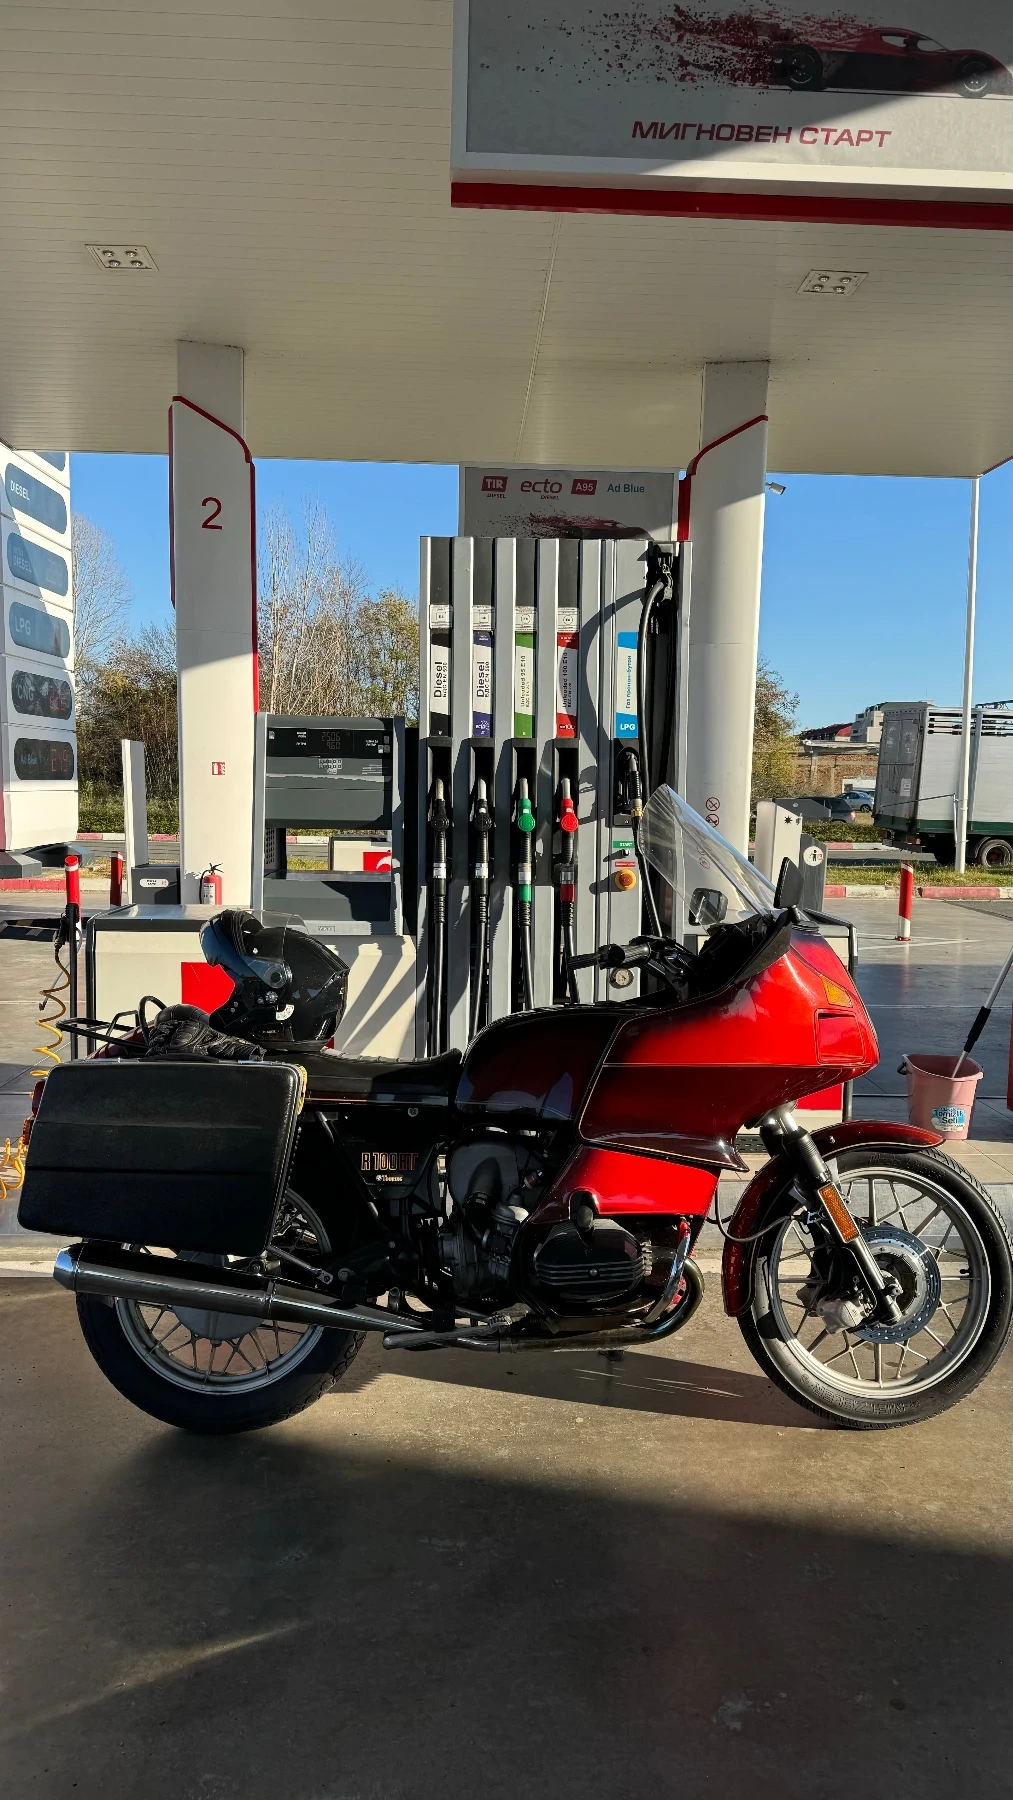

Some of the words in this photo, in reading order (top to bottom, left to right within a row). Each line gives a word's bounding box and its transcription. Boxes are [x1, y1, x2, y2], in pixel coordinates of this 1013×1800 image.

[631, 120, 793, 145] МИГНОВЕН
[798, 125, 893, 149] СТАРТ
[10, 479, 31, 502] DIESEL
[485, 478, 504, 490] TIR
[520, 478, 563, 494] ecto
[575, 481, 594, 493] A95
[607, 483, 622, 493] Ad
[623, 483, 645, 494] Blue
[201, 496, 224, 530] 2
[12, 554, 33, 573] DIESEL
[14, 615, 31, 636] LPG
[433, 661, 443, 698] Diesel
[476, 661, 485, 698] Diesel
[17, 685, 35, 702] CNG
[619, 722, 636, 731] LPG
[361, 1152, 371, 1171] R
